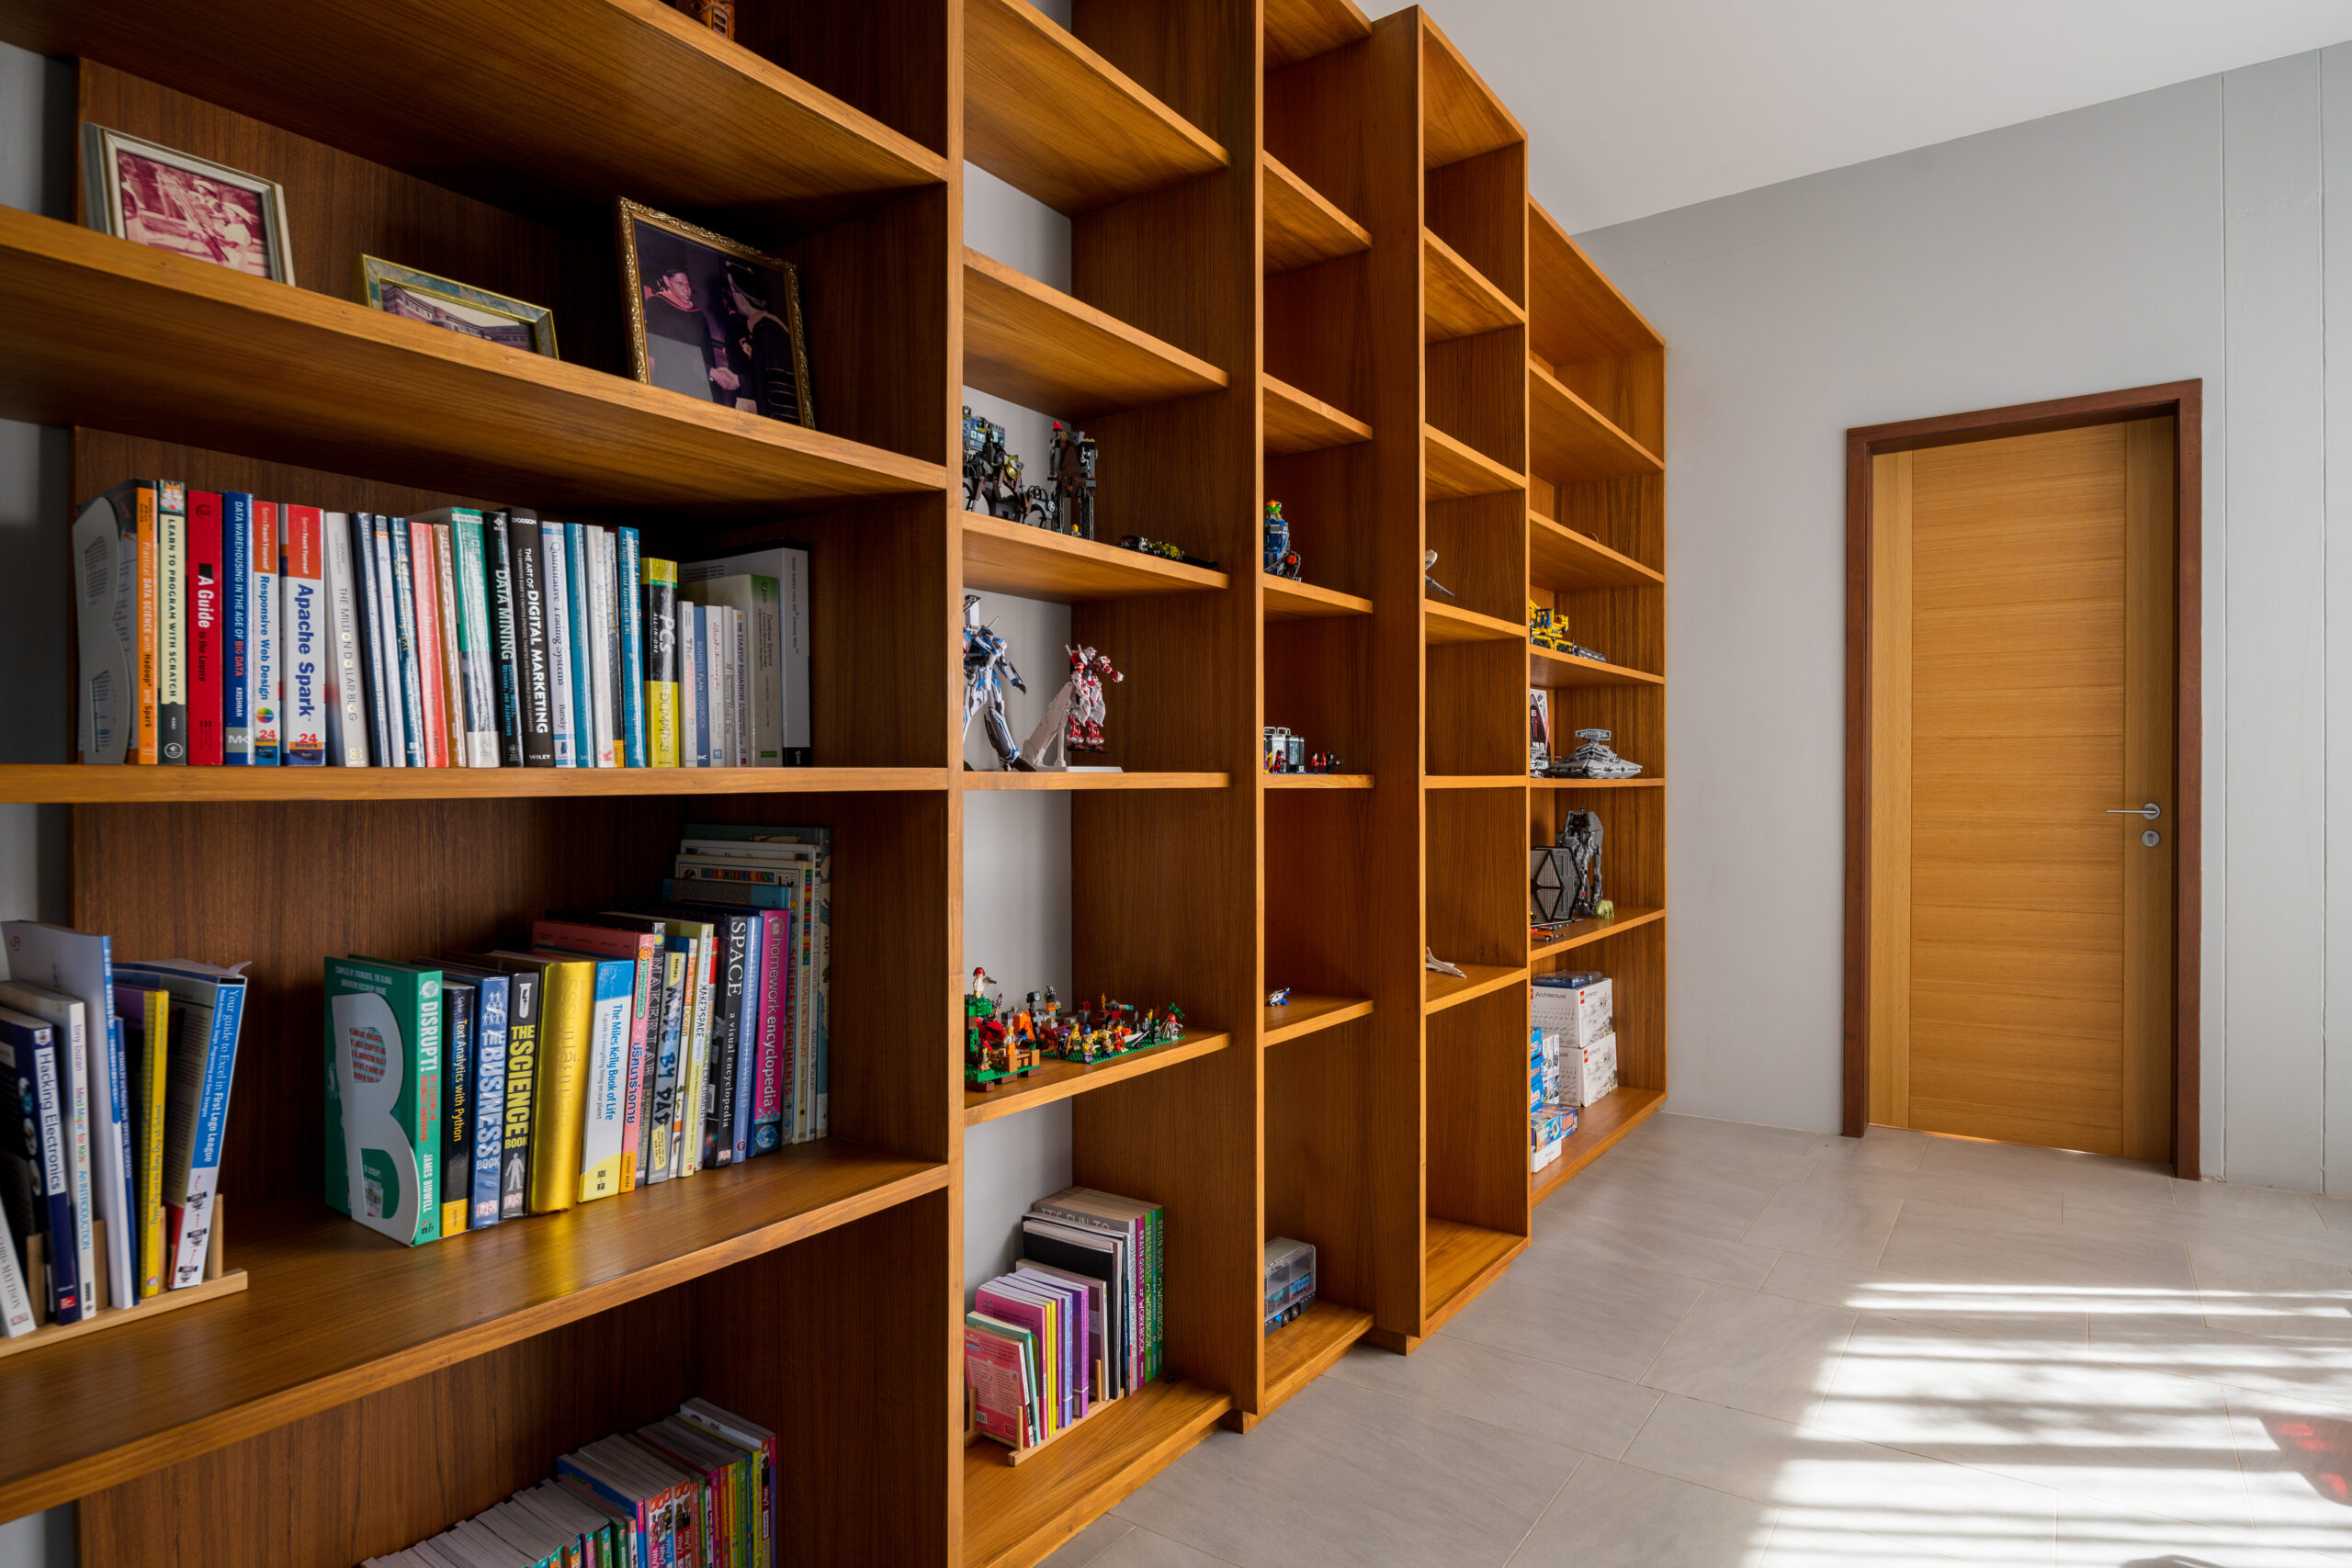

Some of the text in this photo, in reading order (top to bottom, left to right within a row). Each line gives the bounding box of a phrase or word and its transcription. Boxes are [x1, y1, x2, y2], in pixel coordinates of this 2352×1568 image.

[512, 517, 537, 525] DODSON
[142, 542, 151, 576] Practical
[525, 548, 533, 561] THE
[142, 578, 151, 599] DATA
[198, 575, 214, 586] A
[234, 502, 243, 676] DATA WAREHOUSING IN THE AGE OF BIG DATA
[495, 570, 509, 604] DATA
[526, 578, 534, 589] OF
[142, 600, 151, 634] SCIENCE
[168, 519, 176, 697] LEARN TO PROGRAM WITH SCRATCH
[198, 590, 214, 628] Guide
[294, 584, 314, 655] Apache
[527, 590, 542, 646] DIGITAL
[549, 542, 566, 686] Quantitative Trading Systems
[142, 635, 151, 652] with
[198, 640, 207, 653] the
[257, 576, 270, 701] Responsive Web Design
[498, 607, 514, 660] MINING
[659, 615, 675, 653] PCs
[198, 655, 208, 682] Louvre
[338, 588, 357, 722] THE MILLION DOLLAR BLOG
[696, 641, 705, 671] BUSINESS
[766, 643, 775, 667] Systems
[142, 689, 151, 704] and
[235, 687, 243, 716] KRISHNAN
[530, 649, 548, 734] MARKETING
[143, 705, 152, 728] Spark
[558, 704, 567, 729] Bandy
[259, 729, 277, 739] 24
[300, 733, 318, 743] 24
[727, 920, 747, 998] SPACE
[682, 959, 696, 1037] Eye Wonder Ocean
[801, 970, 810, 997] VISUAL
[600, 1018, 608, 1032] guide
[643, 958, 663, 1077] MAKER LAB
[695, 984, 708, 1039] MAKERSPACE
[762, 937, 784, 1107] homework encyclopedia
[785, 948, 797, 1096] SCIENCE EXPERIMENTS
[799, 998, 809, 1058] DICTIONARY
[419, 1001, 439, 1073] DISRUPT!
[481, 1030, 505, 1047] THE
[511, 1024, 536, 1040] THE
[727, 1022, 736, 1054] visual
[598, 1040, 607, 1068] everything
[605, 1003, 623, 1121] The Miles Kelly Book of Life
[659, 1050, 676, 1078] BY
[203, 989, 240, 1162] Your guide to Excel in First Lego League
[451, 1019, 467, 1142] Text Analytics with Python
[504, 1040, 534, 1138] SCIENCE
[597, 1068, 605, 1084] living
[721, 1056, 735, 1128] encyclopedia
[420, 1075, 429, 1142] BUSINESS INNOVATION
[429, 1085, 437, 1111] LESSONS
[476, 1047, 504, 1157] BUSINESS
[595, 1102, 604, 1120] planet
[653, 1087, 674, 1127] DAD
[39, 1053, 62, 1190] Hacking Electronics
[429, 1111, 437, 1121] IN
[504, 1137, 528, 1149] BOOK
[476, 1156, 501, 1171] BOOK
[423, 1153, 434, 1213] JAMES BIDWELL
[78, 1170, 91, 1250] An INTRODUCTION
[477, 1201, 497, 1217] DK
[504, 1193, 523, 1210] DK
